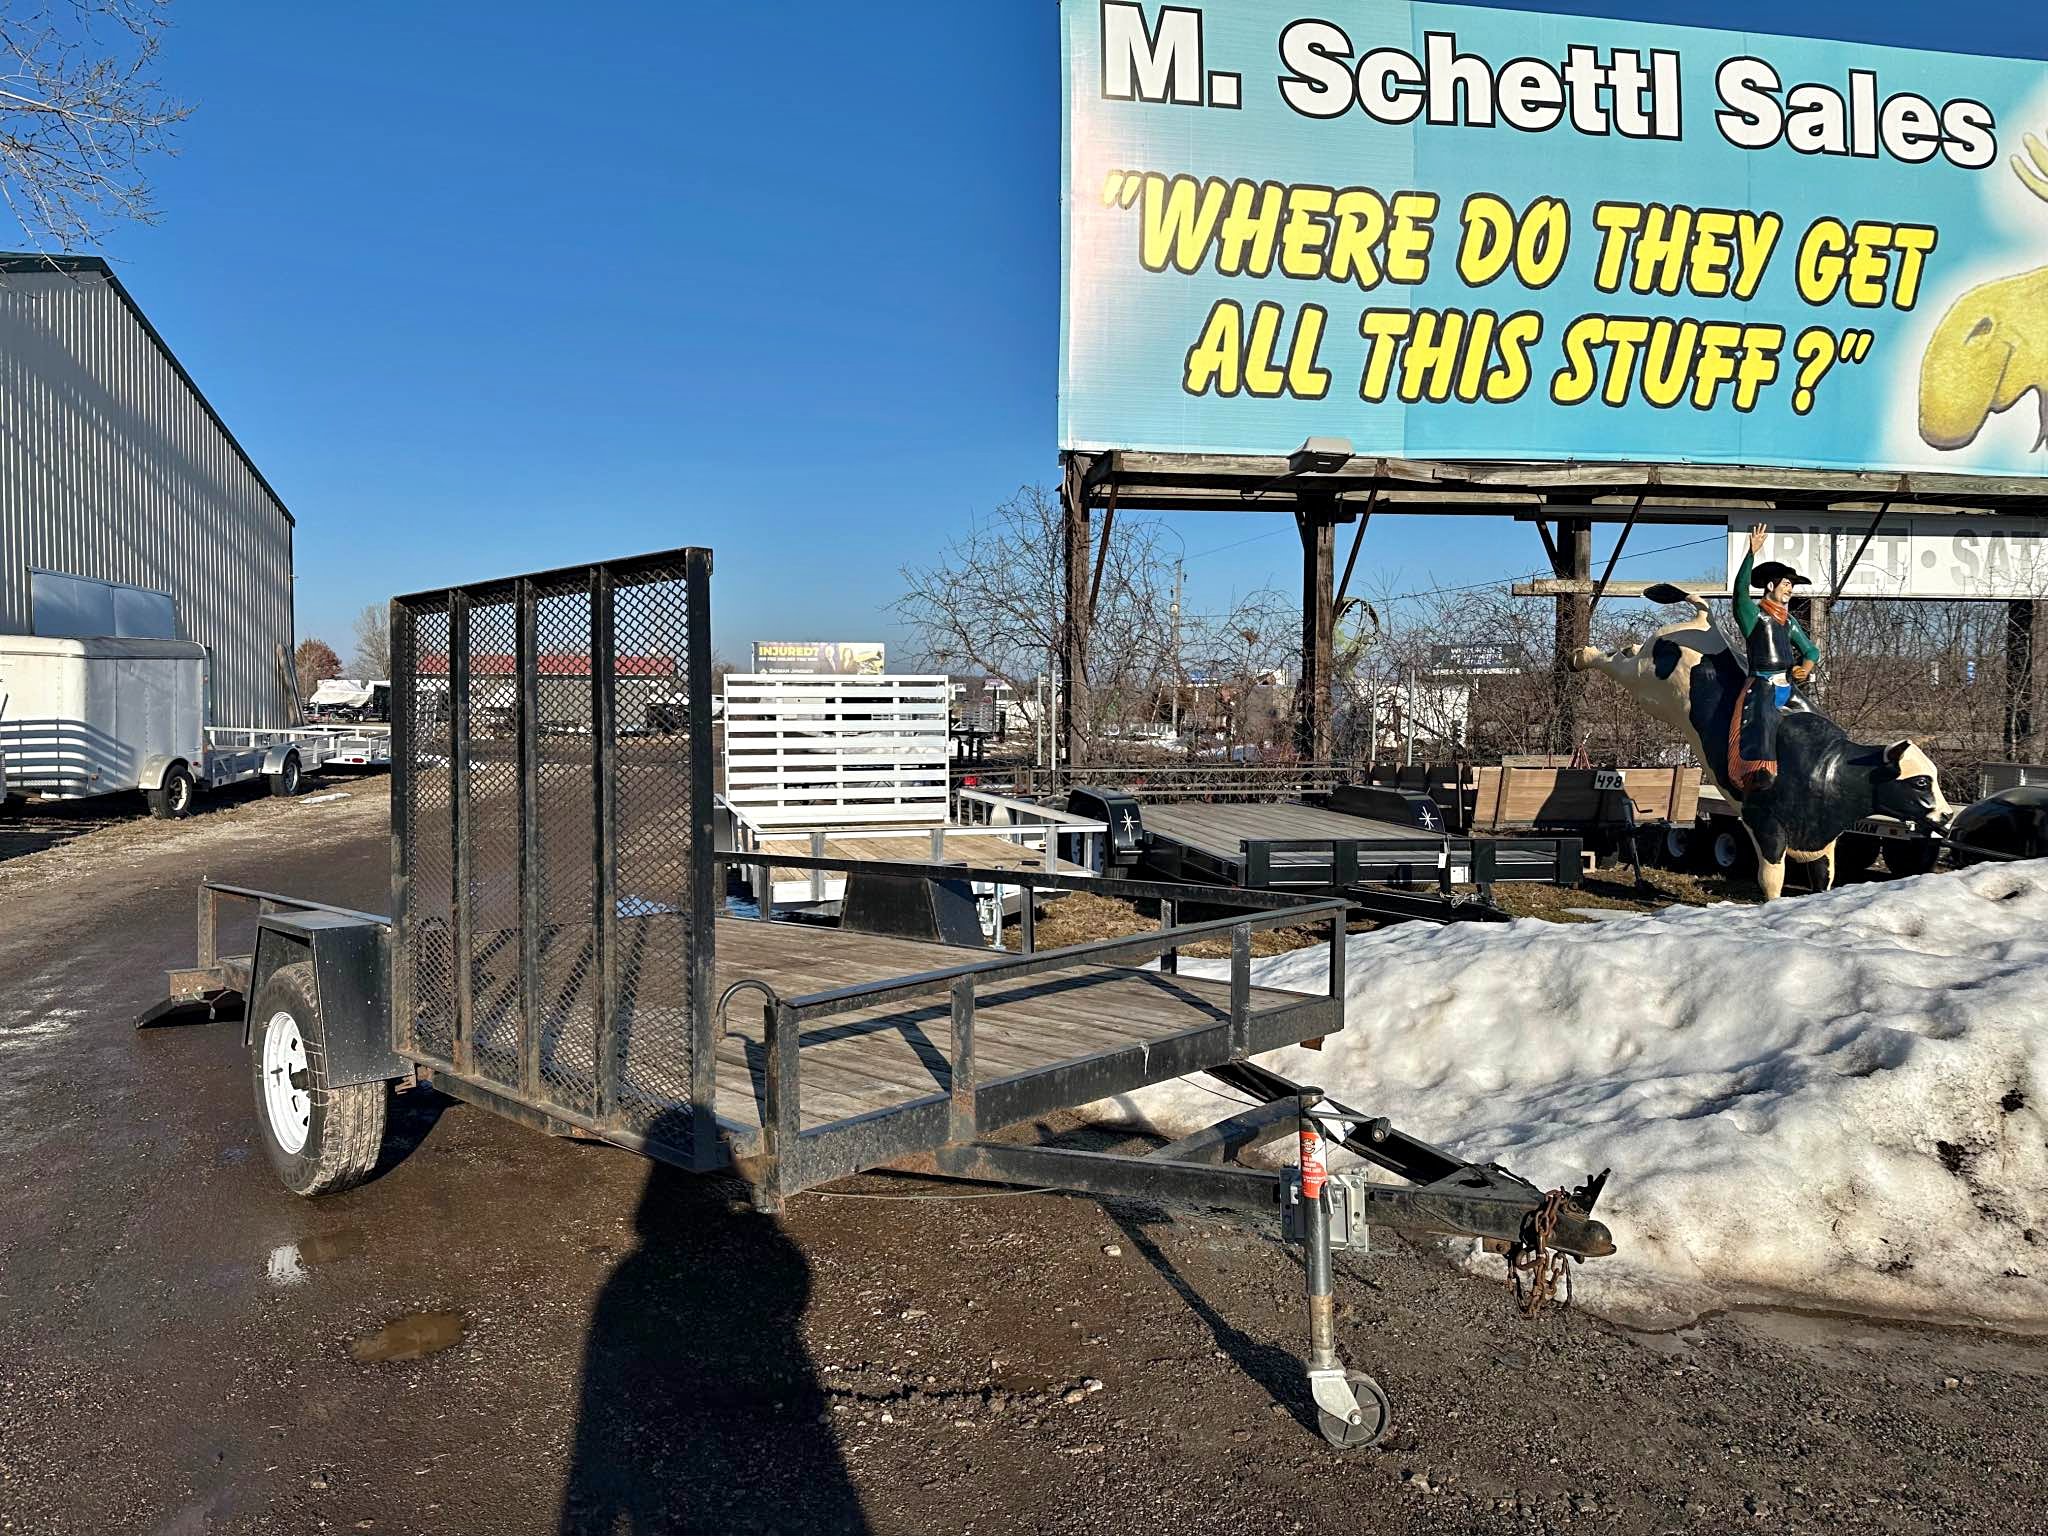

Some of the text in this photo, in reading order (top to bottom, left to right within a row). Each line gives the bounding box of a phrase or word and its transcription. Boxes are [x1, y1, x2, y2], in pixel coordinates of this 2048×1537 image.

[1100, 0, 1997, 169] M. Schettl Sales
[1103, 169, 1938, 311] "WHERE DO THEY GET
[1182, 298, 1332, 400] ALL
[1358, 307, 1543, 403] THIS
[759, 646, 819, 657] INJURED?
[1596, 774, 1623, 789] 498
